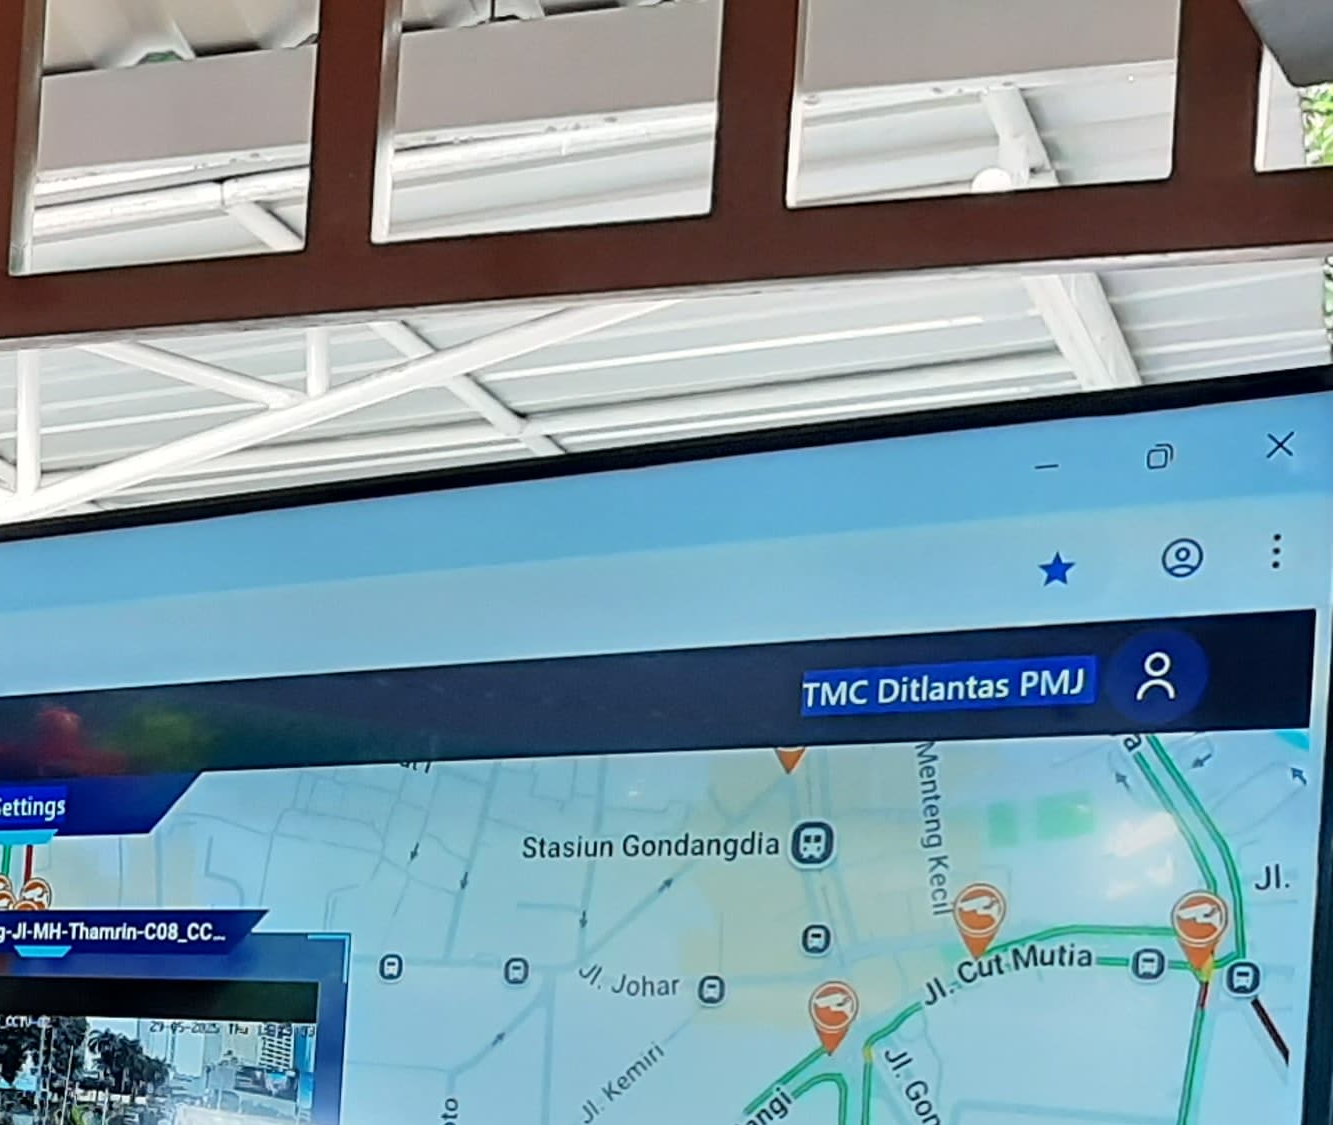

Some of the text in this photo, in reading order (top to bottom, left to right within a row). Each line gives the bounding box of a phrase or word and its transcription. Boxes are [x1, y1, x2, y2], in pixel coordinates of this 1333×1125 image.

[803, 667, 1085, 708] TMC Ditlantas PMJ
[522, 831, 780, 862] Stasiun Gondangdia
[915, 740, 952, 916] Menteng Kecil
[1254, 864, 1290, 891] Jl.
[578, 965, 680, 998] Jl. Johar
[924, 944, 1093, 1007] Jl. Cut Mutia
[884, 1048, 910, 1079] Jl.
[582, 1042, 666, 1125] Jl. Kemiri
